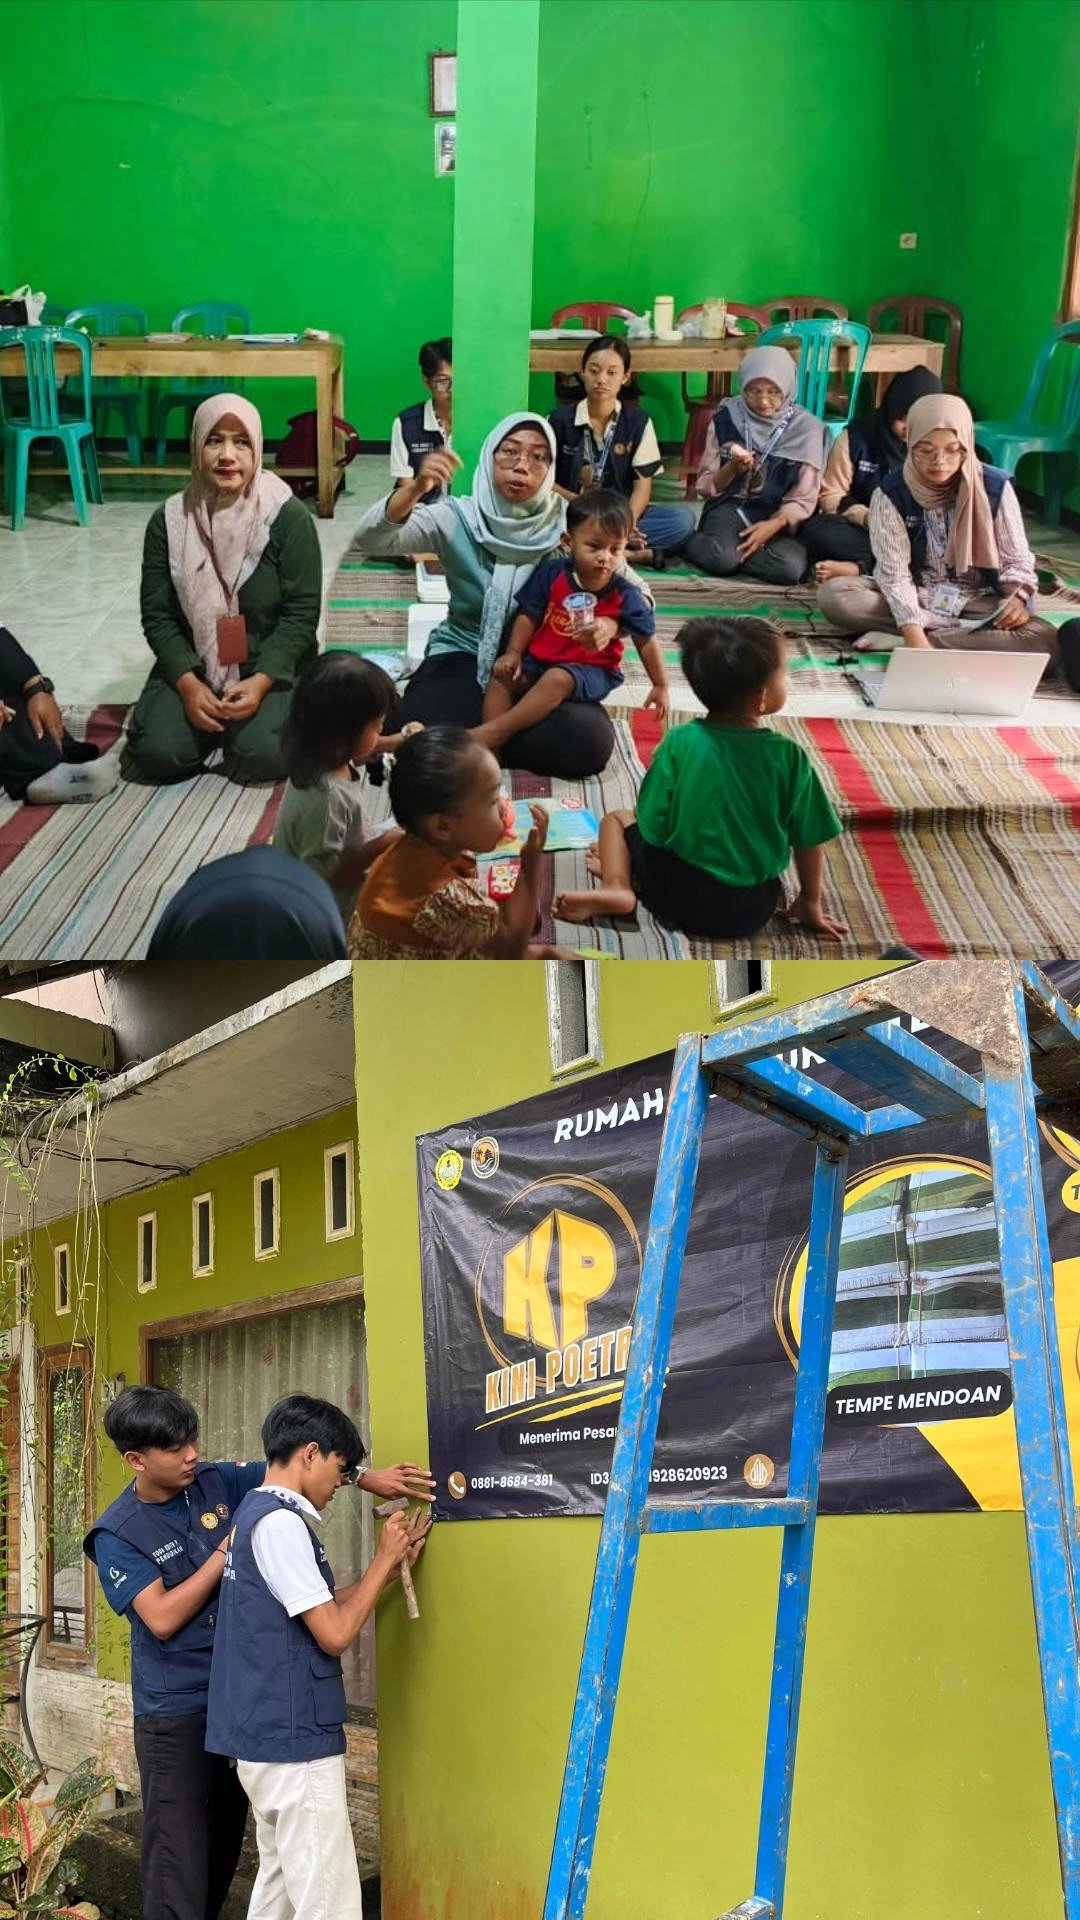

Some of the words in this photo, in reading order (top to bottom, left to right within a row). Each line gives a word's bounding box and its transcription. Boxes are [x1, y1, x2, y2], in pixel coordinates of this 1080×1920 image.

[553, 1087, 664, 1144] RUMAH
[503, 1208, 617, 1353] KP
[485, 1358, 536, 1413] KINI
[835, 1395, 894, 1415] TEMPE
[897, 1385, 1002, 1410] MENDOAN
[519, 1428, 580, 1445] Menerima
[471, 1473, 553, 1490] 0881-8684-381
